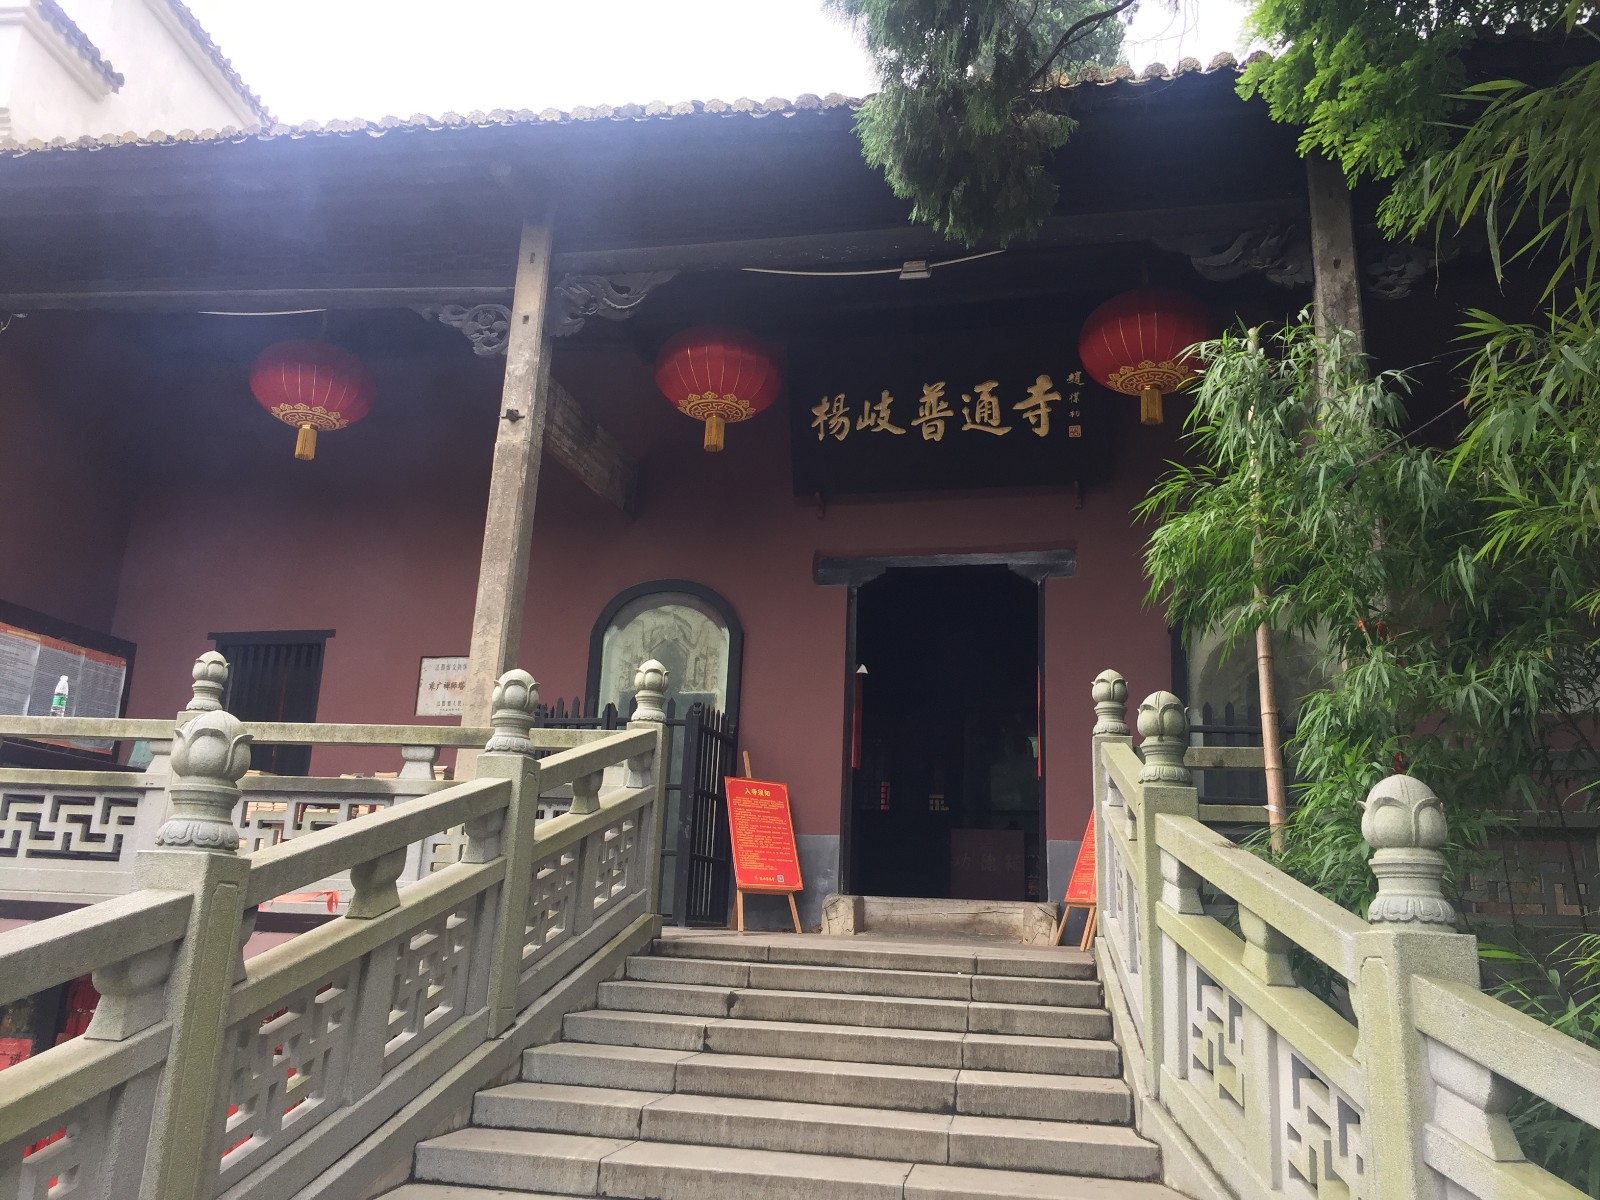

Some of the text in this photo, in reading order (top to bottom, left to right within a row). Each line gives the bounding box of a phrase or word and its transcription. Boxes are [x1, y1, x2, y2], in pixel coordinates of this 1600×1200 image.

[810, 374, 1062, 441] 楊岐普通寺
